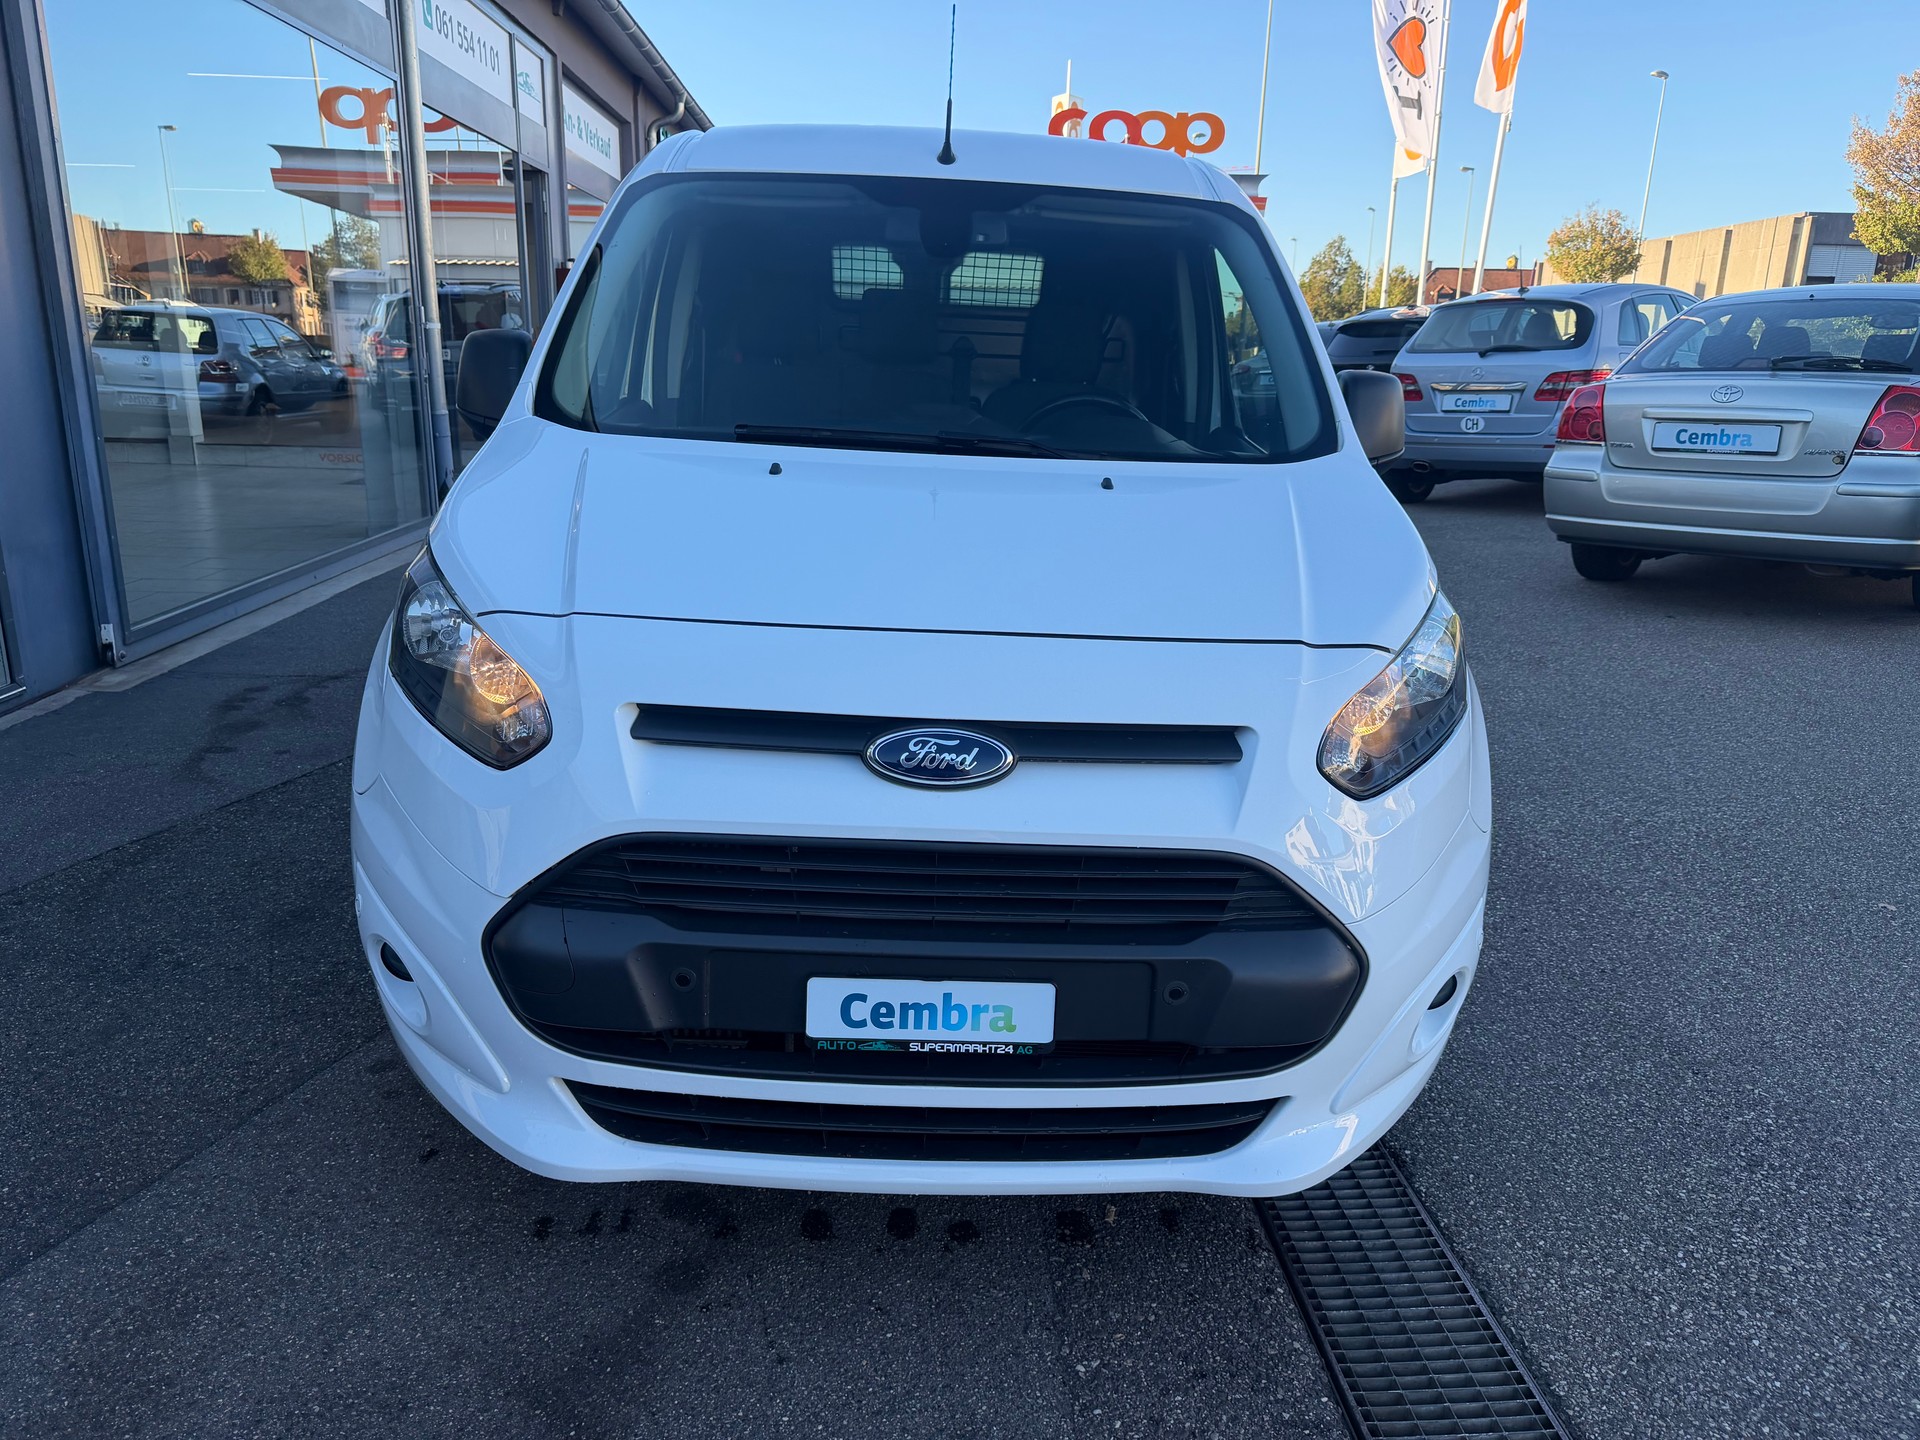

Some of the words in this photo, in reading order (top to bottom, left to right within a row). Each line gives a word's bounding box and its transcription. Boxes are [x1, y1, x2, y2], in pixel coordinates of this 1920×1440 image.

[435, 4, 454, 44] 061
[457, 20, 475, 58] 554
[477, 36, 488, 67] 11
[489, 45, 500, 76] 01
[577, 114, 584, 141] &
[583, 119, 611, 160] Verkauf
[1048, 109, 1226, 158] coop
[1454, 397, 1497, 409] Cembra
[1464, 417, 1480, 431] CH
[1675, 428, 1753, 447] Cembra
[900, 737, 980, 771] Ford
[840, 992, 1018, 1033] Cembra
[817, 1040, 856, 1051] AUTO
[908, 1042, 1014, 1054] SUPERMARKT24
[1016, 1045, 1034, 1055] AG
